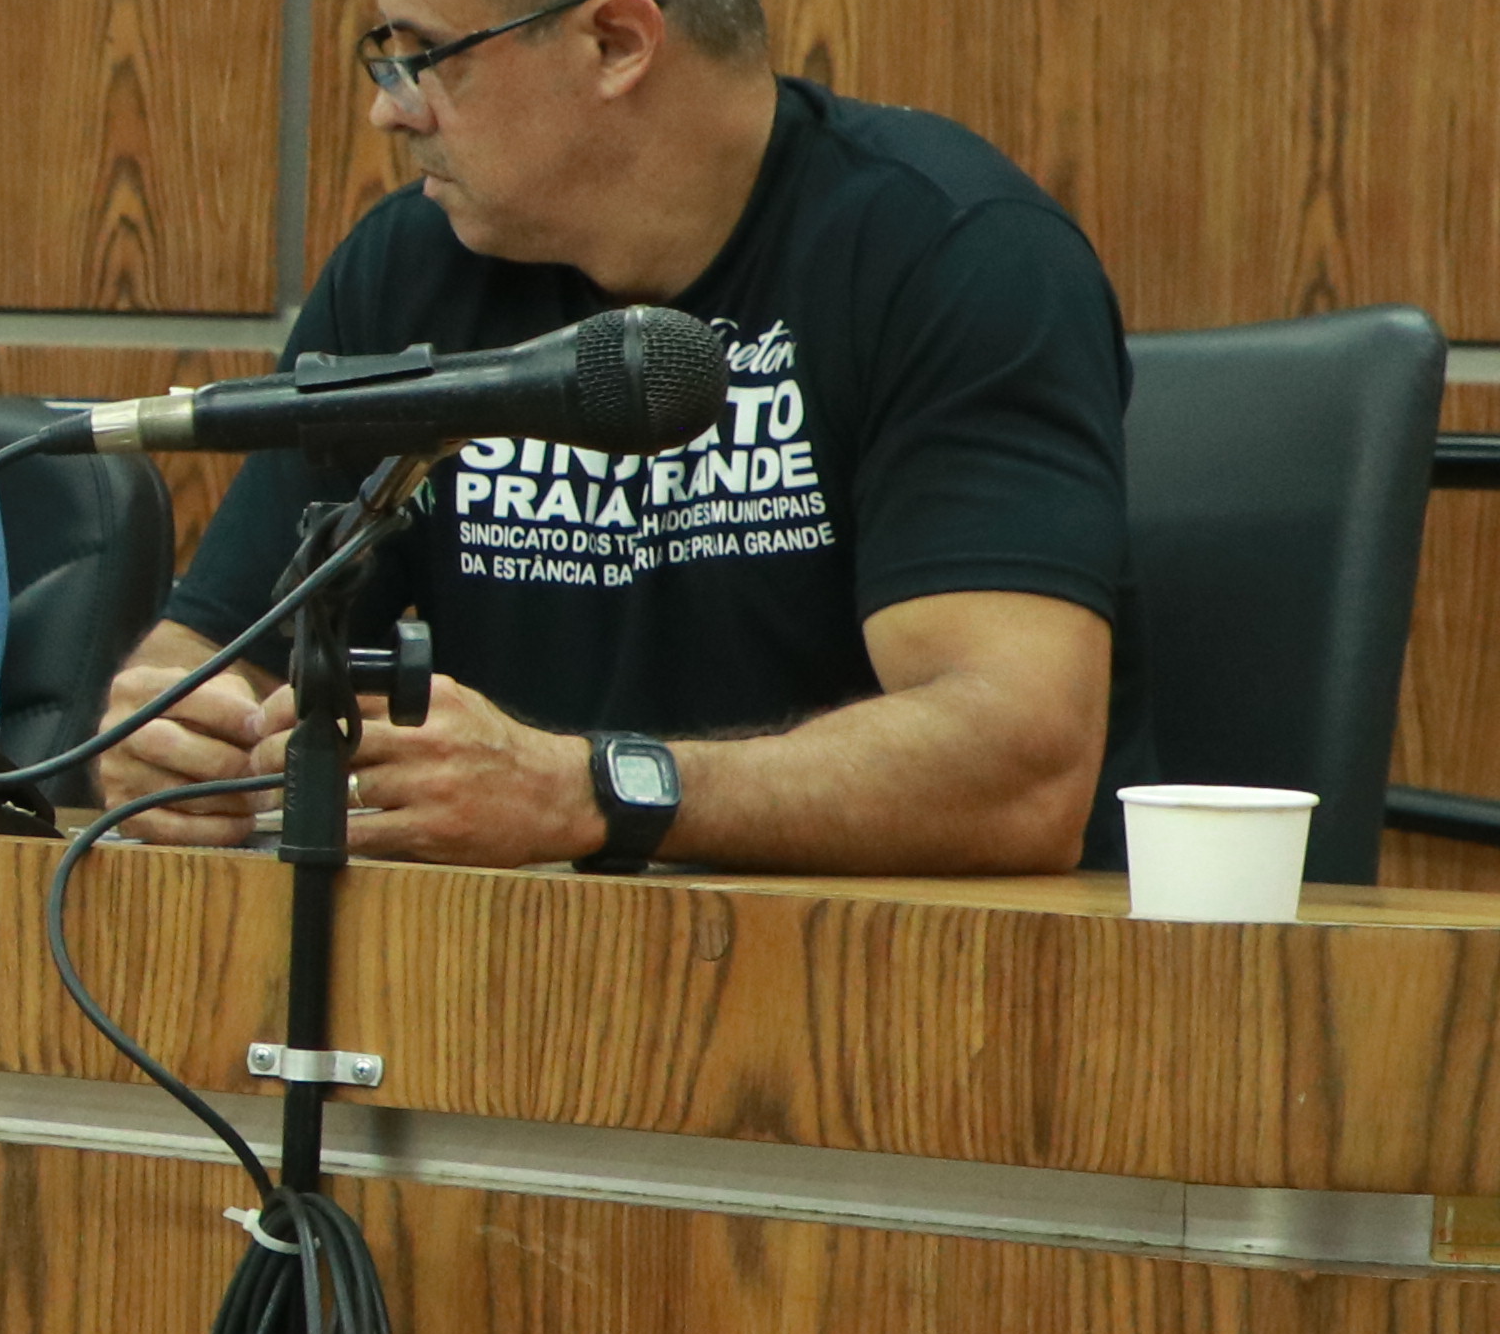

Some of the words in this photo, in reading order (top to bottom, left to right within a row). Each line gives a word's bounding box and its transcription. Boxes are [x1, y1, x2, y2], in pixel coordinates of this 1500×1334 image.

[455, 471, 638, 528] PRAIA
[641, 440, 819, 507] RANDE
[459, 520, 568, 552] SINDICATO
[460, 552, 487, 575] DA
[492, 553, 597, 586] ESTÂNCIA
[744, 521, 836, 556] GRANDE
